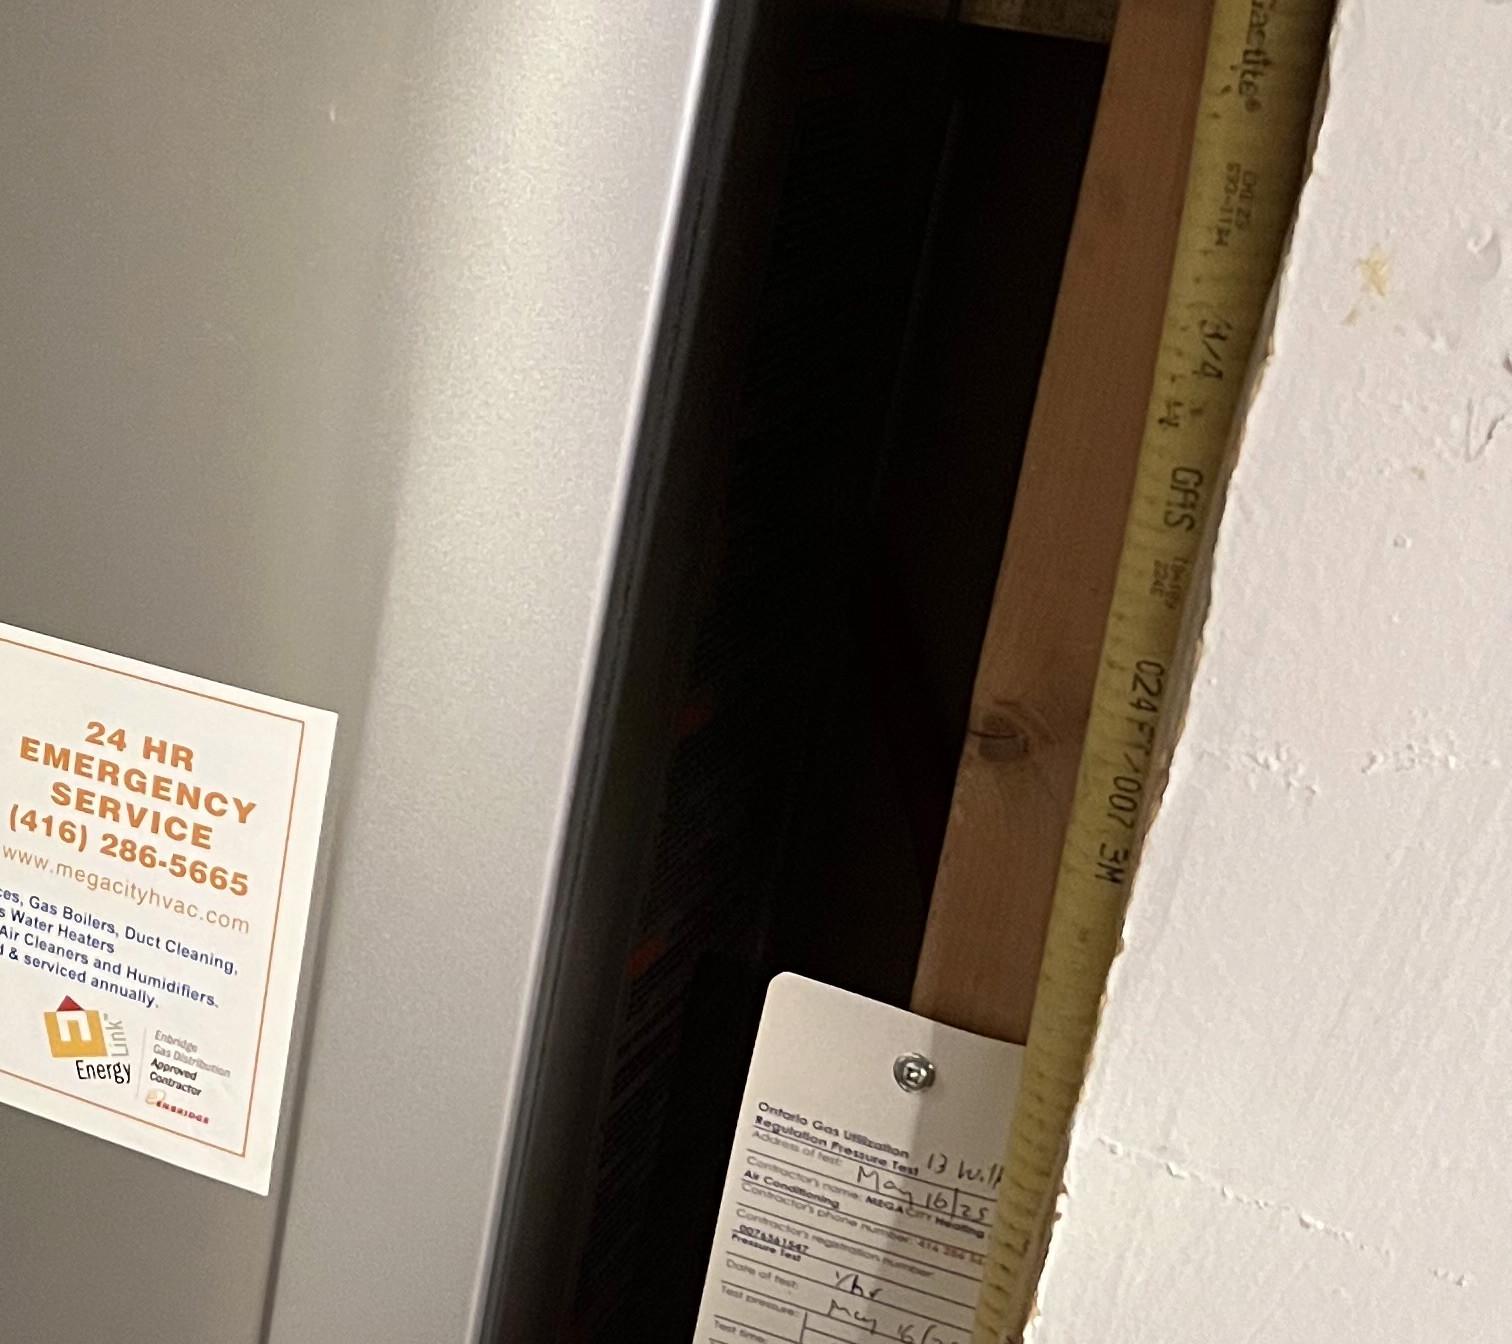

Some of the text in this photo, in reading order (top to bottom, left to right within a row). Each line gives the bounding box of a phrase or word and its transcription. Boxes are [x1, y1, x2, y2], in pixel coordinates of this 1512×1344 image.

[85, 721, 195, 773] 24 HR
[20, 736, 257, 824] EMERGENCY
[50, 781, 213, 850] SERVICE
[9, 804, 249, 896] (416) 286-5665
[2, 844, 250, 934] www.megacityhvac.com
[10, 908, 54, 934] Water
[58, 924, 115, 954] Heaters
[29, 896, 58, 916] Gas
[63, 905, 119, 937] Boilers,
[125, 926, 161, 950] Duct
[165, 939, 238, 976] Cleaning,
[8, 947, 18, 961] &
[24, 954, 86, 984] serviced
[91, 975, 160, 1009] annually.
[24, 933, 89, 965] Cleaners
[93, 958, 121, 976] and
[126, 965, 219, 1009] Humidifiers.
[153, 1044, 171, 1059] Gas
[155, 1029, 198, 1053] Enbridge
[75, 1060, 131, 1085] Energy
[150, 1058, 198, 1081] Approved
[150, 1071, 202, 1097] Contractor
[758, 1101, 808, 1126] Ontario
[812, 1120, 840, 1137] Gas
[754, 1115, 919, 1177] Regulation Pressure Test
[763, 1175, 840, 1210] Conditioning
